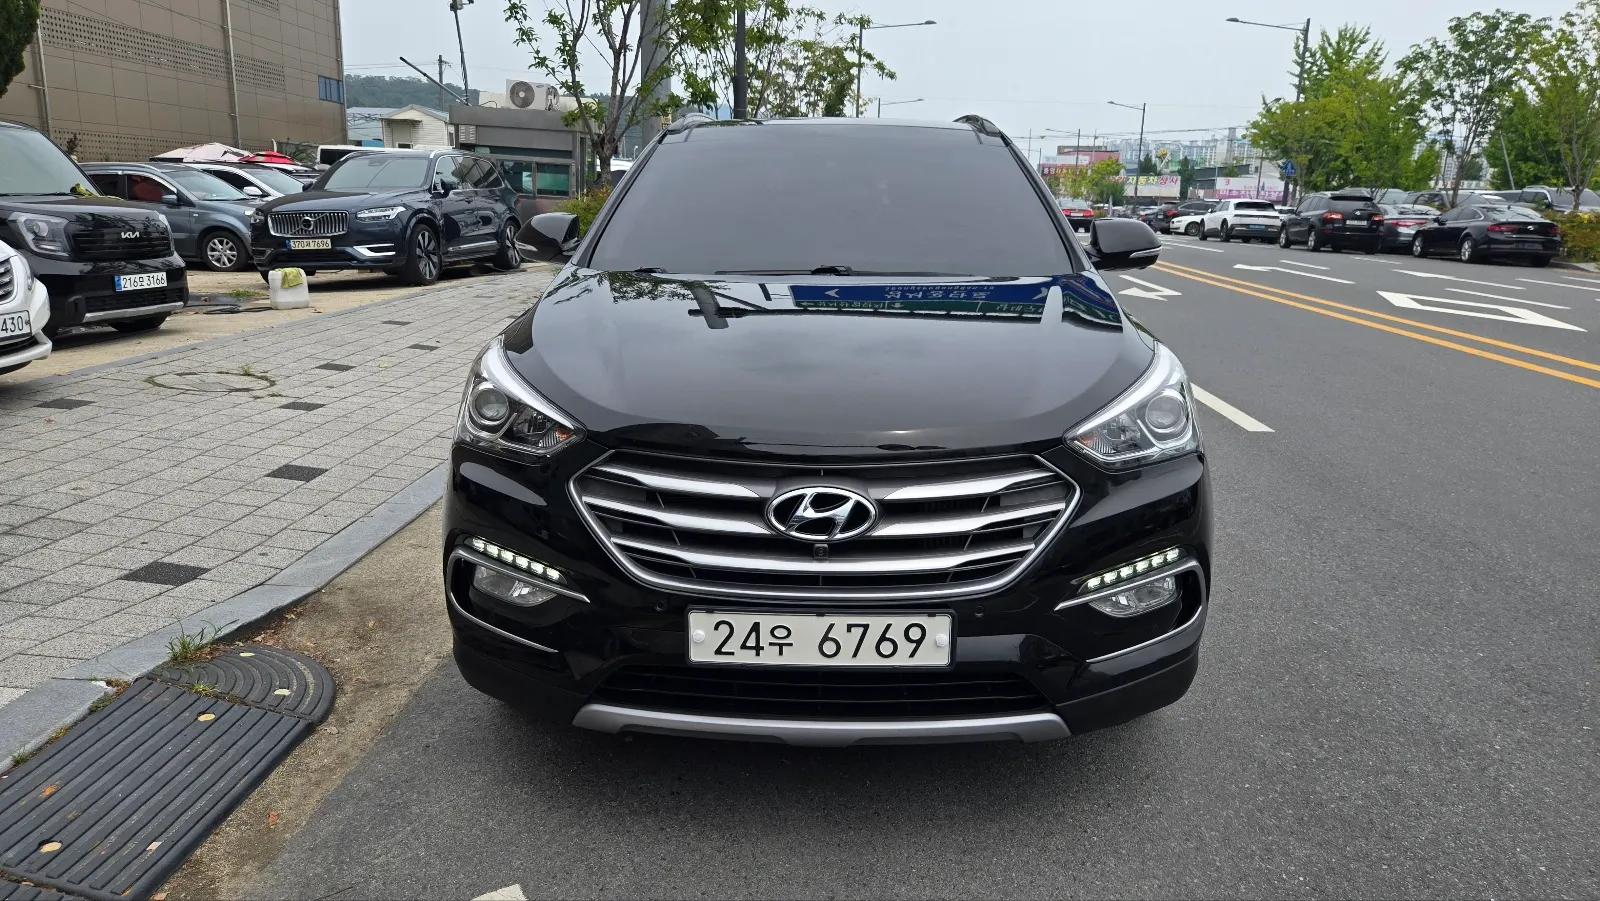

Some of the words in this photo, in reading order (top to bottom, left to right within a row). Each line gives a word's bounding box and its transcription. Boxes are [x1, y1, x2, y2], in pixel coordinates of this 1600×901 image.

[146, 274, 166, 287] 3166
[0, 315, 24, 333] 430
[713, 619, 794, 657] 24우
[817, 622, 927, 659] 6769
